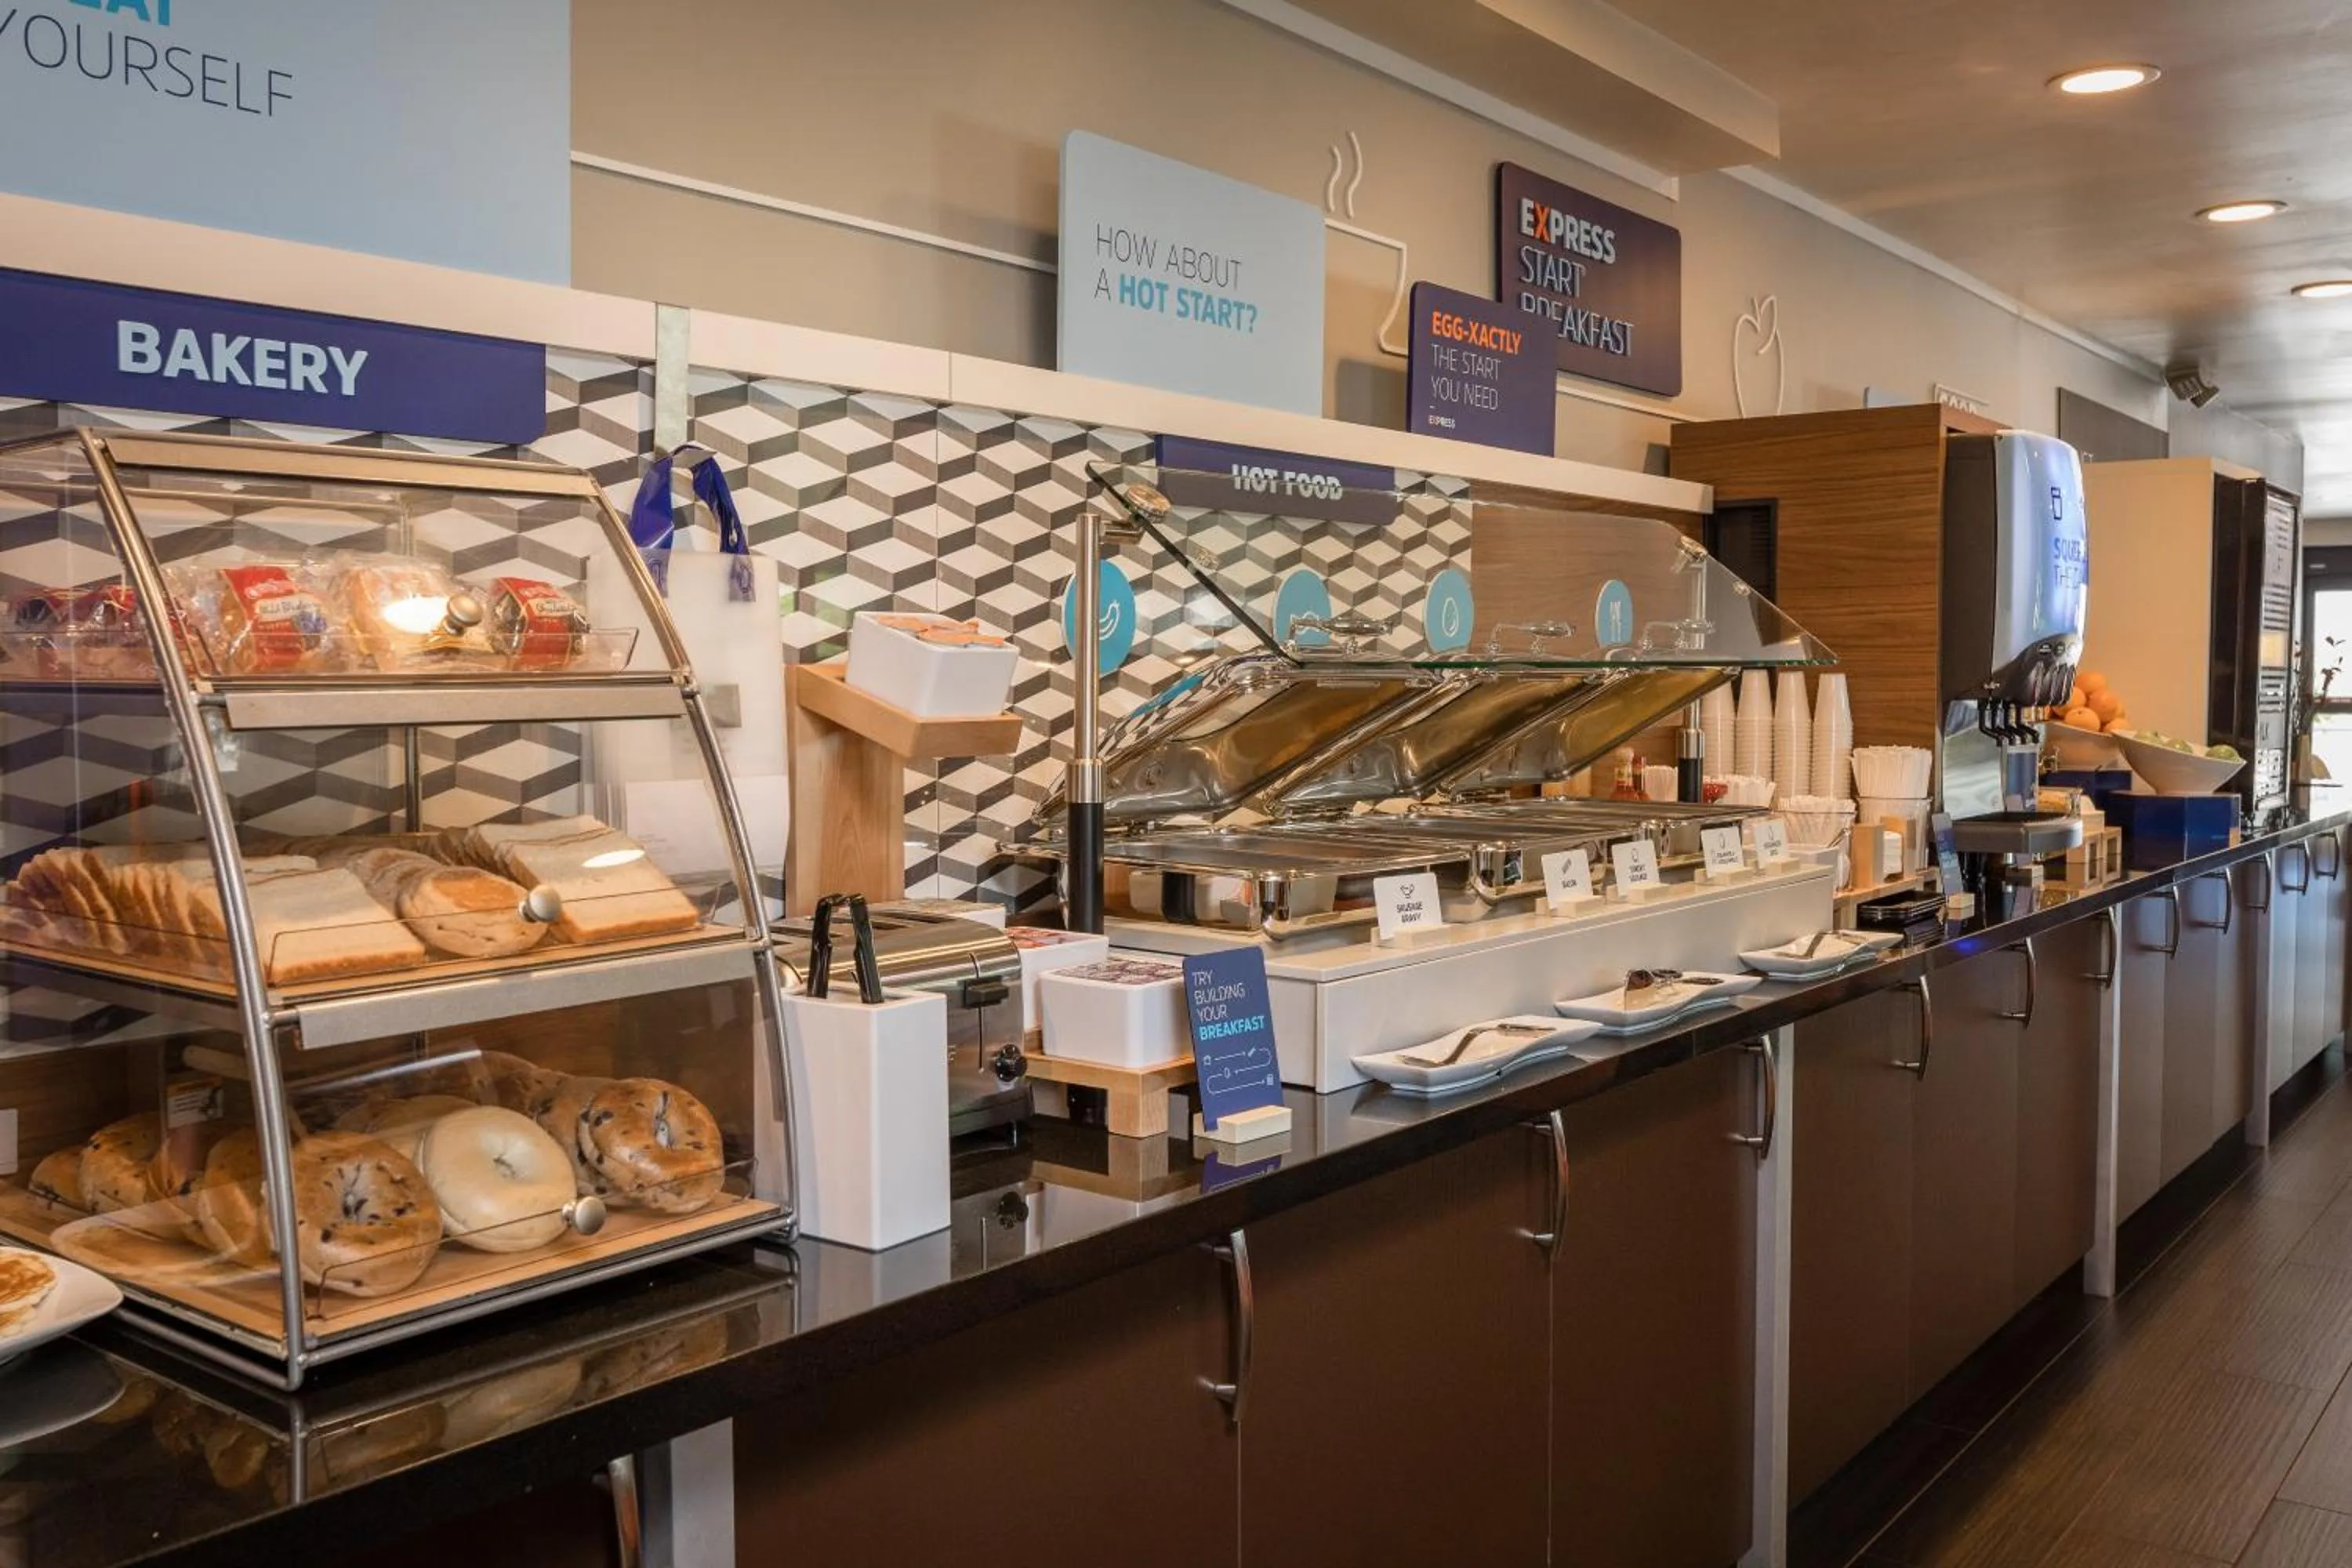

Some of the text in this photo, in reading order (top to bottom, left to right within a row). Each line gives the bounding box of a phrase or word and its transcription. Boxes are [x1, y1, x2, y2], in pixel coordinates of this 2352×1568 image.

[1520, 198, 1616, 265] EXPRESS
[1096, 223, 1243, 292] HOW ABOUT
[1519, 245, 1584, 299] START
[1094, 267, 1258, 334] A HOT START?
[1432, 310, 1523, 355] EGG-XACTLY
[118, 320, 368, 396] BAKERY
[1431, 343, 1502, 381] THE START
[1431, 376, 1499, 411] YOU NEED
[1428, 414, 1456, 430] EXPRESS
[1232, 463, 1344, 501] HOT FOOD
[1192, 969, 1214, 985] TRY
[1194, 982, 1246, 1005] BUILDING
[1196, 1004, 1228, 1022] YOUR
[1198, 1014, 1265, 1041] BREAKFAST
